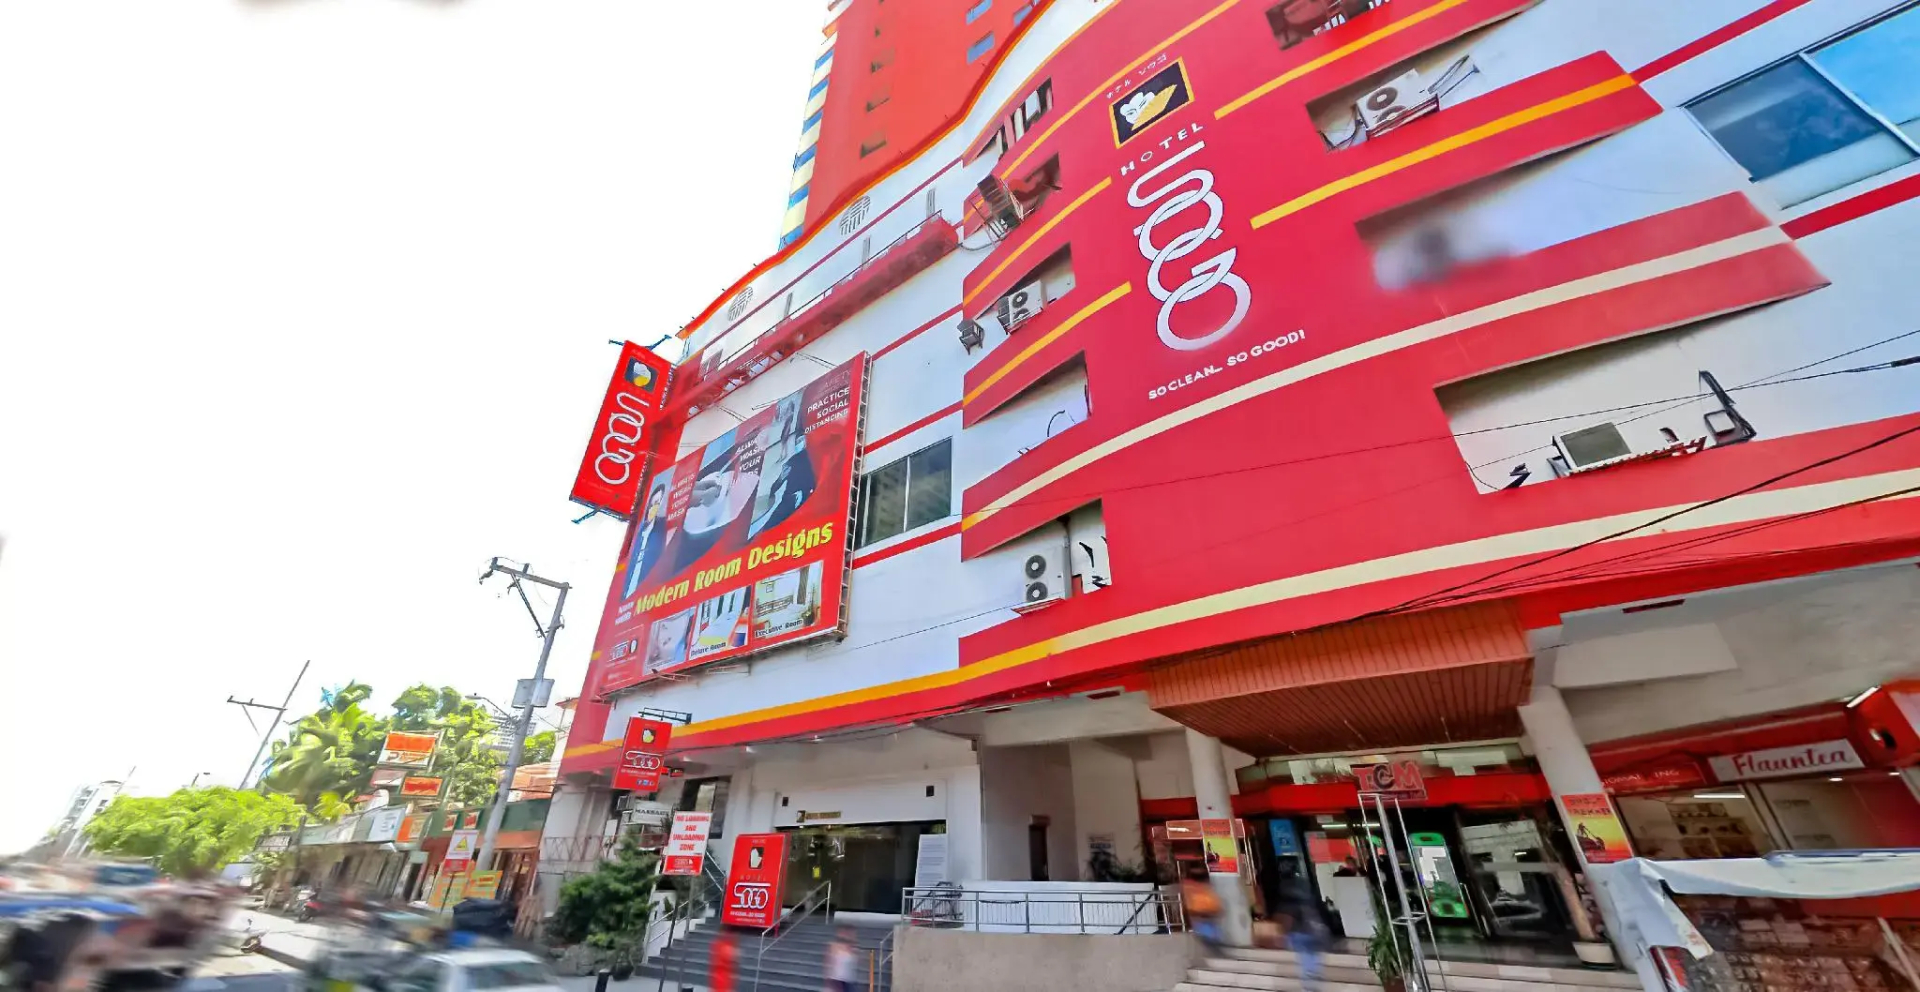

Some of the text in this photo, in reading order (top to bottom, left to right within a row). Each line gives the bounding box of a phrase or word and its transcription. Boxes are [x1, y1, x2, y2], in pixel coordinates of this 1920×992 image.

[1120, 123, 1203, 176] HOTEL
[1127, 140, 1251, 351] SOGO
[1148, 385, 1167, 400] SO
[1226, 352, 1248, 367] SO
[1250, 329, 1306, 357] GOOD!
[807, 387, 850, 414] PRACTICE
[817, 399, 849, 419] SOCIAL
[804, 409, 849, 433] DISTANCING
[595, 392, 650, 485] SOGO
[634, 580, 690, 616] Modern
[694, 557, 742, 592] Room
[748, 522, 833, 571] Designs
[1352, 761, 1425, 792] TCM
[1732, 748, 1850, 776] Flauntea
[1602, 773, 1641, 785] IOMAI
[731, 882, 771, 909] SOGO
